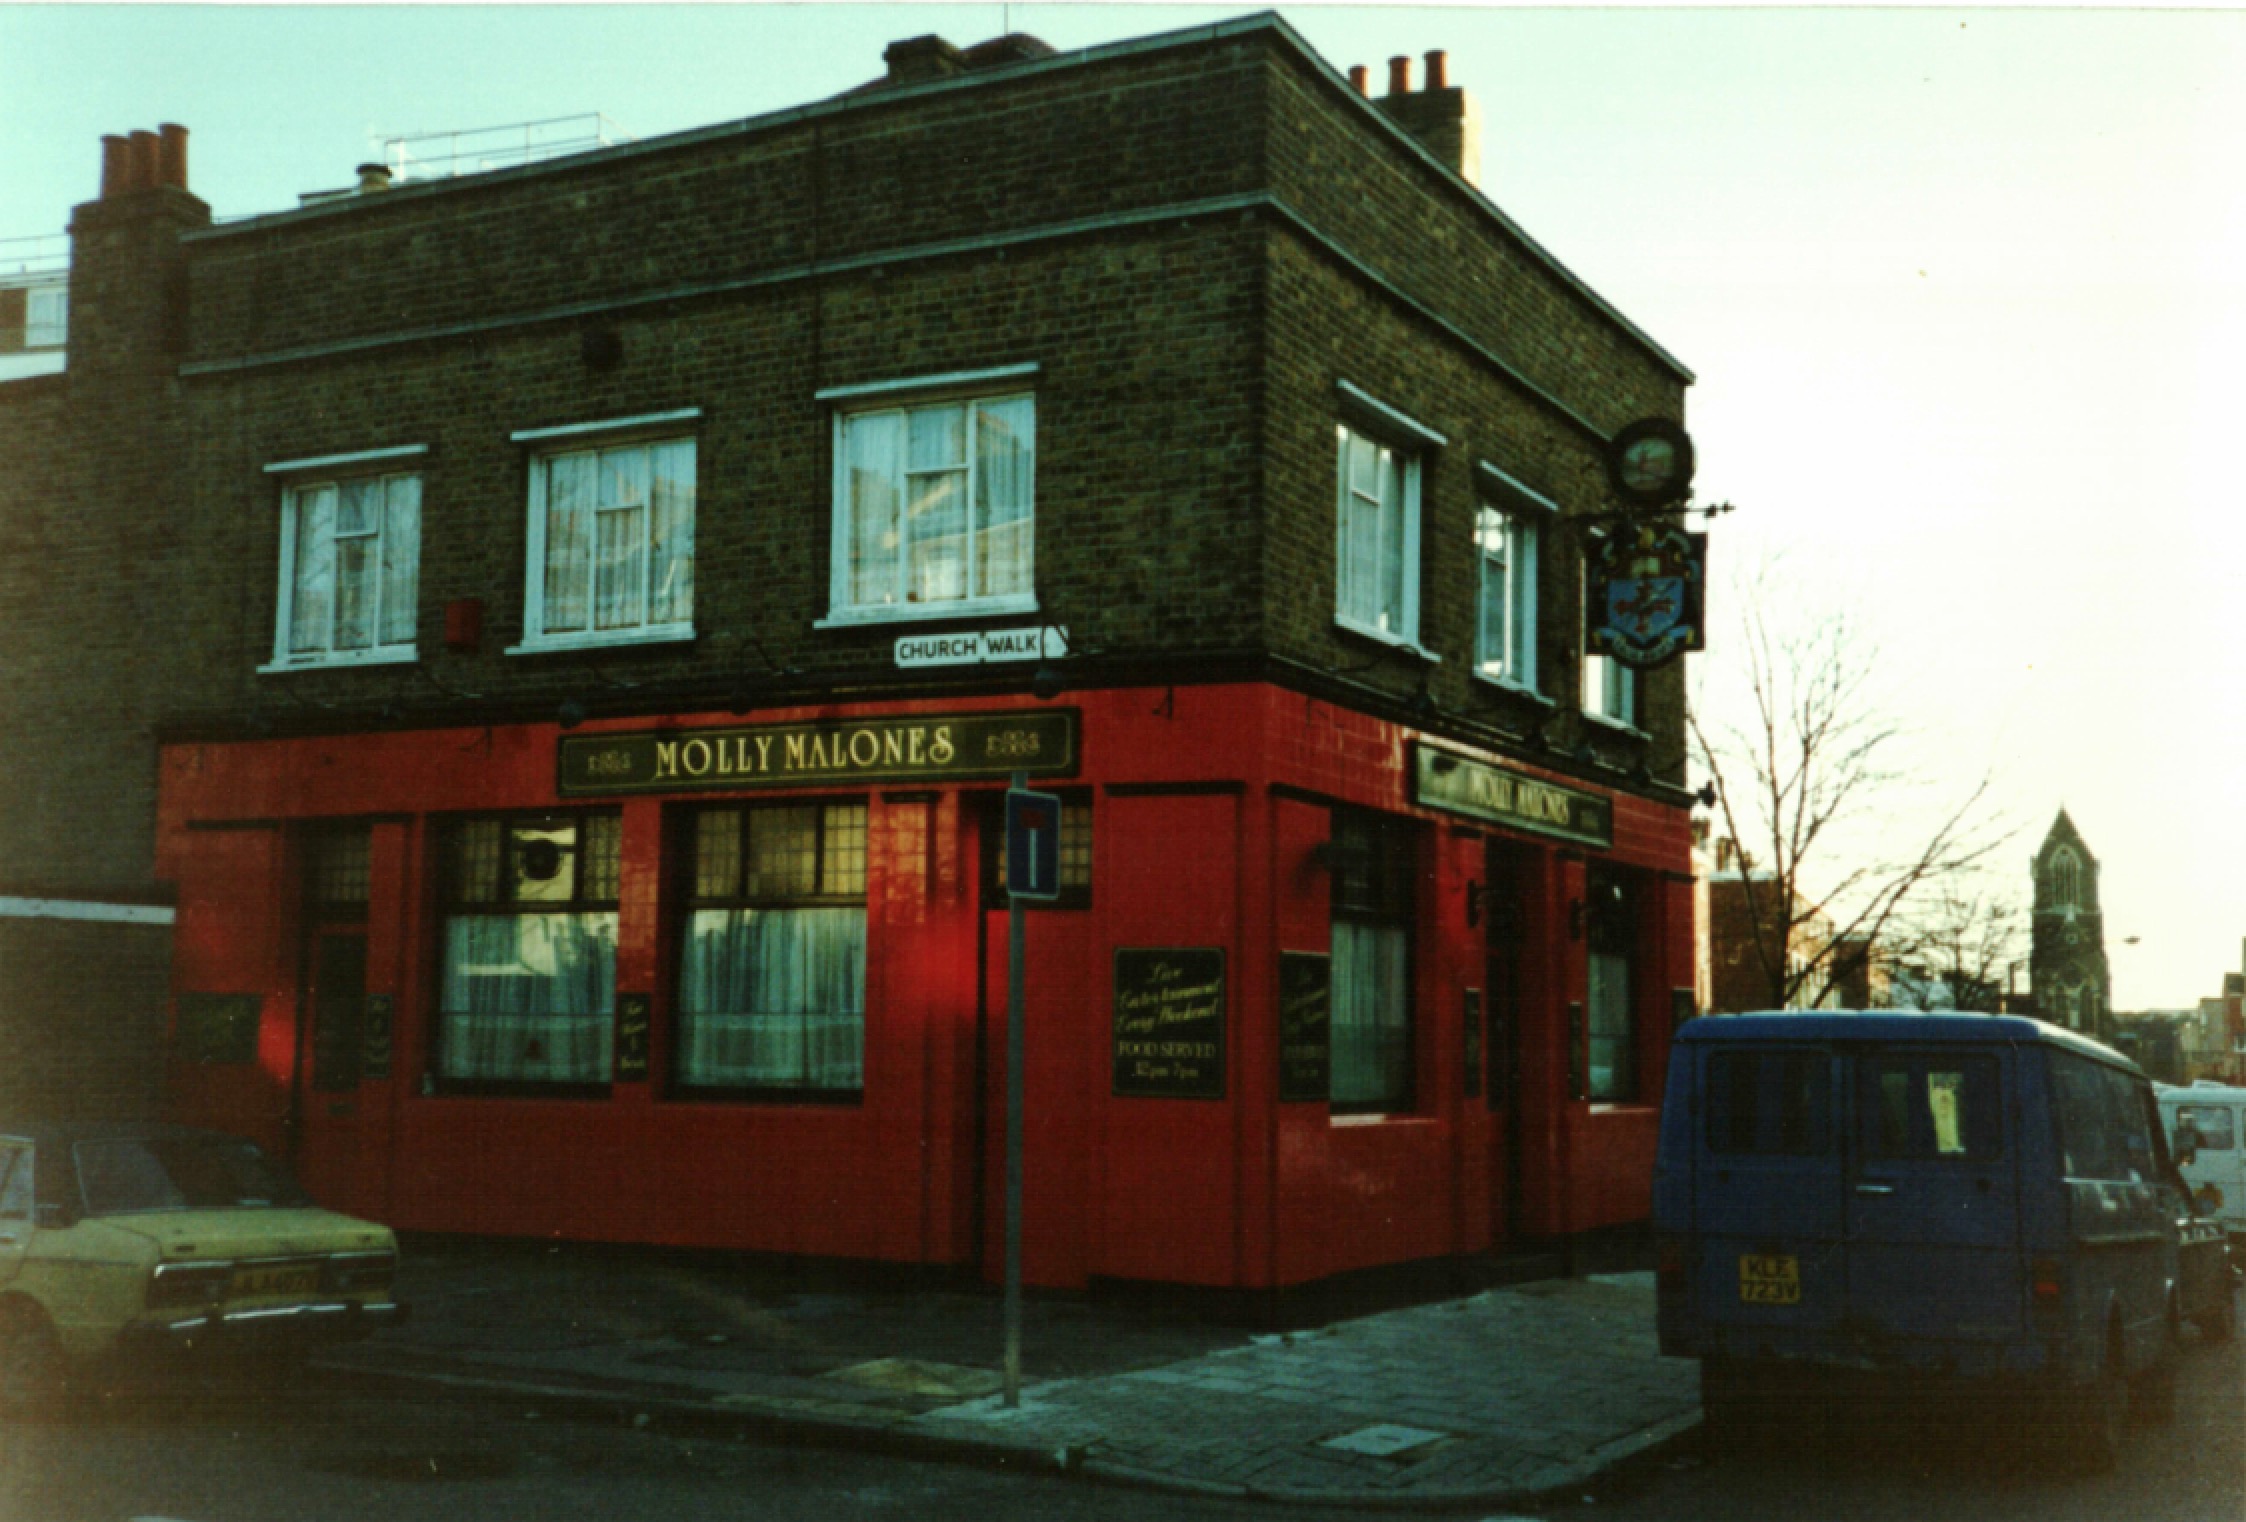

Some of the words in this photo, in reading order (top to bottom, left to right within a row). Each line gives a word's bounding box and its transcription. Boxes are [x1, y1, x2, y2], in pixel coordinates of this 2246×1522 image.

[901, 638, 977, 660] CHURCH
[987, 634, 1037, 654] WALK
[654, 735, 772, 778] MOLLY
[785, 725, 955, 771] MALONES
[1118, 1041, 1158, 1058] FOOD
[1161, 1040, 1216, 1058] SERVED
